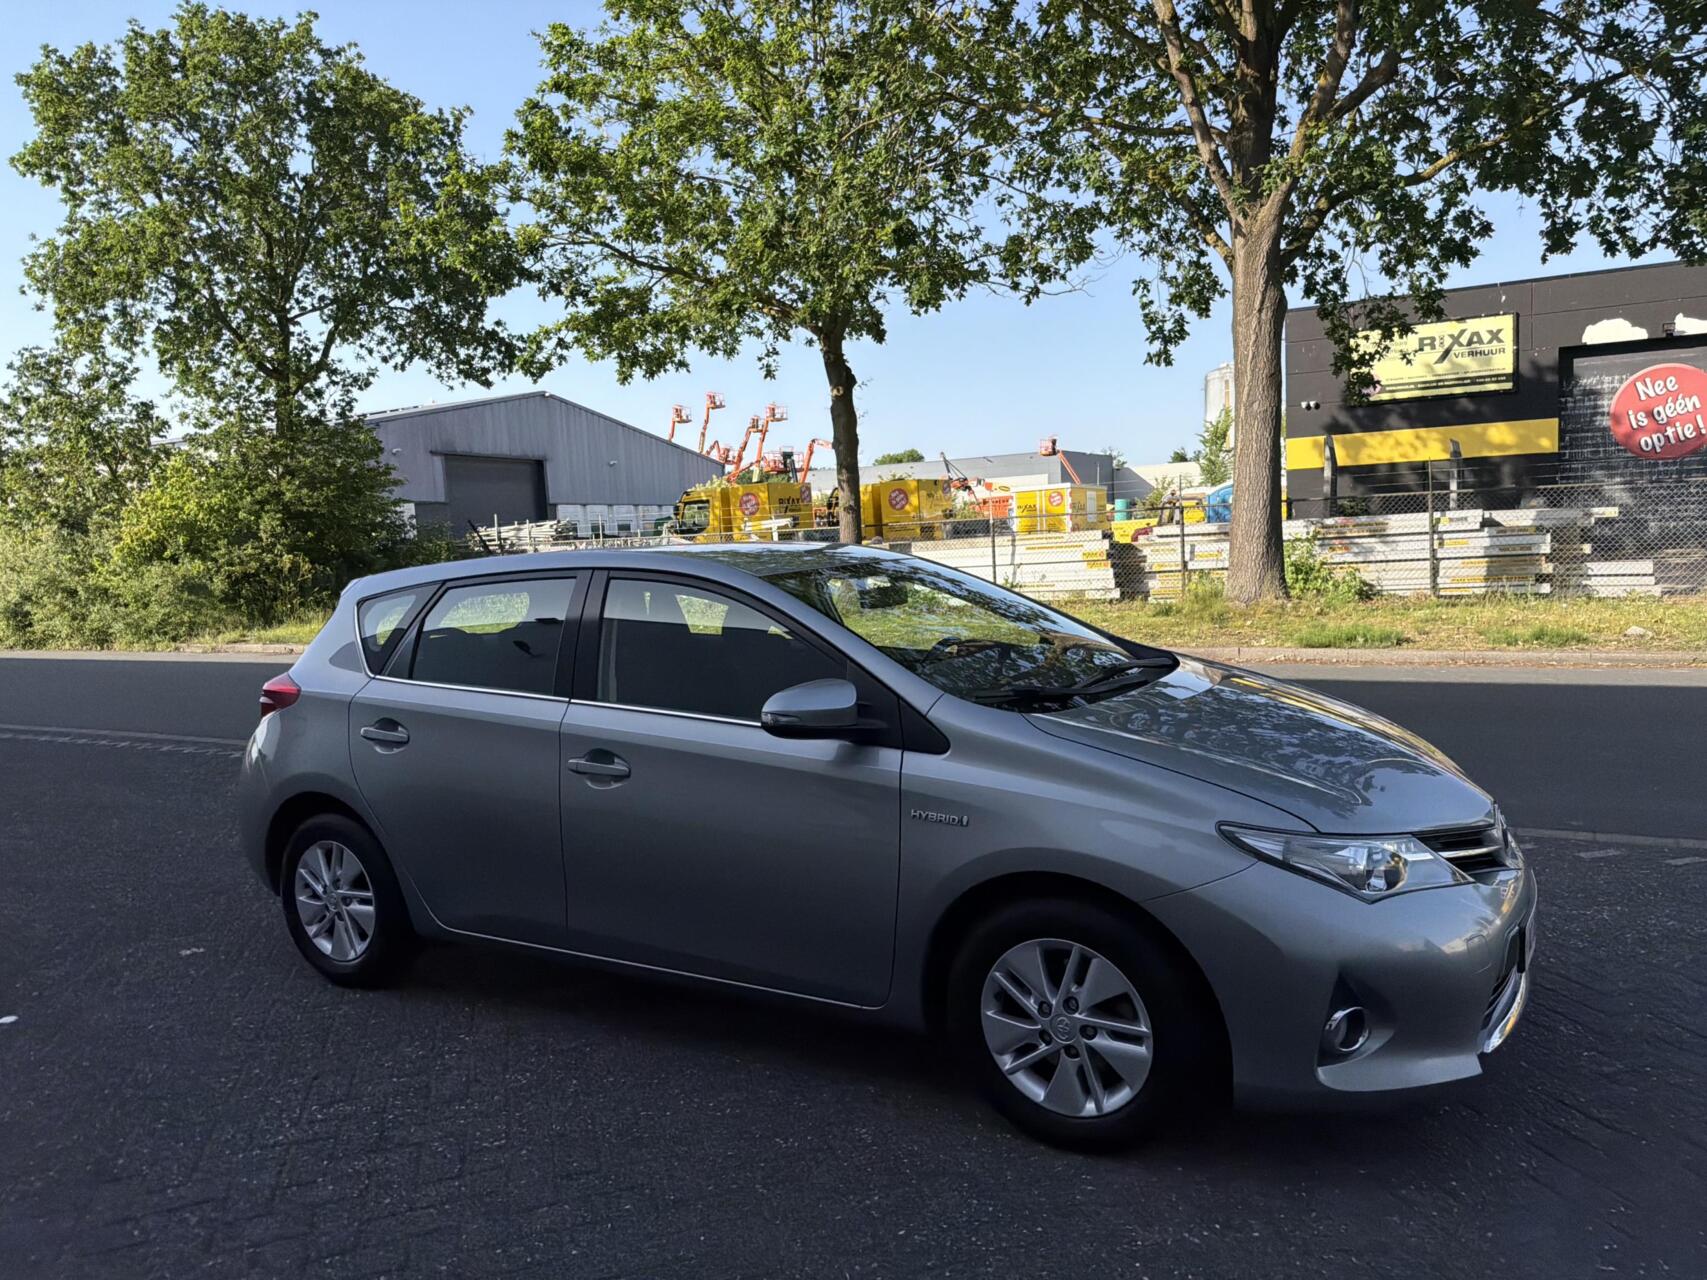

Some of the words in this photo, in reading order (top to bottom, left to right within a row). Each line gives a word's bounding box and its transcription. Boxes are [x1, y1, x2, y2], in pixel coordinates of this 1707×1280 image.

[1453, 347, 1506, 359] VERHUUR
[1635, 376, 1678, 401] Nee
[1627, 409, 1649, 429] is
[1653, 394, 1702, 424] géén
[910, 809, 959, 825] HYBRID
